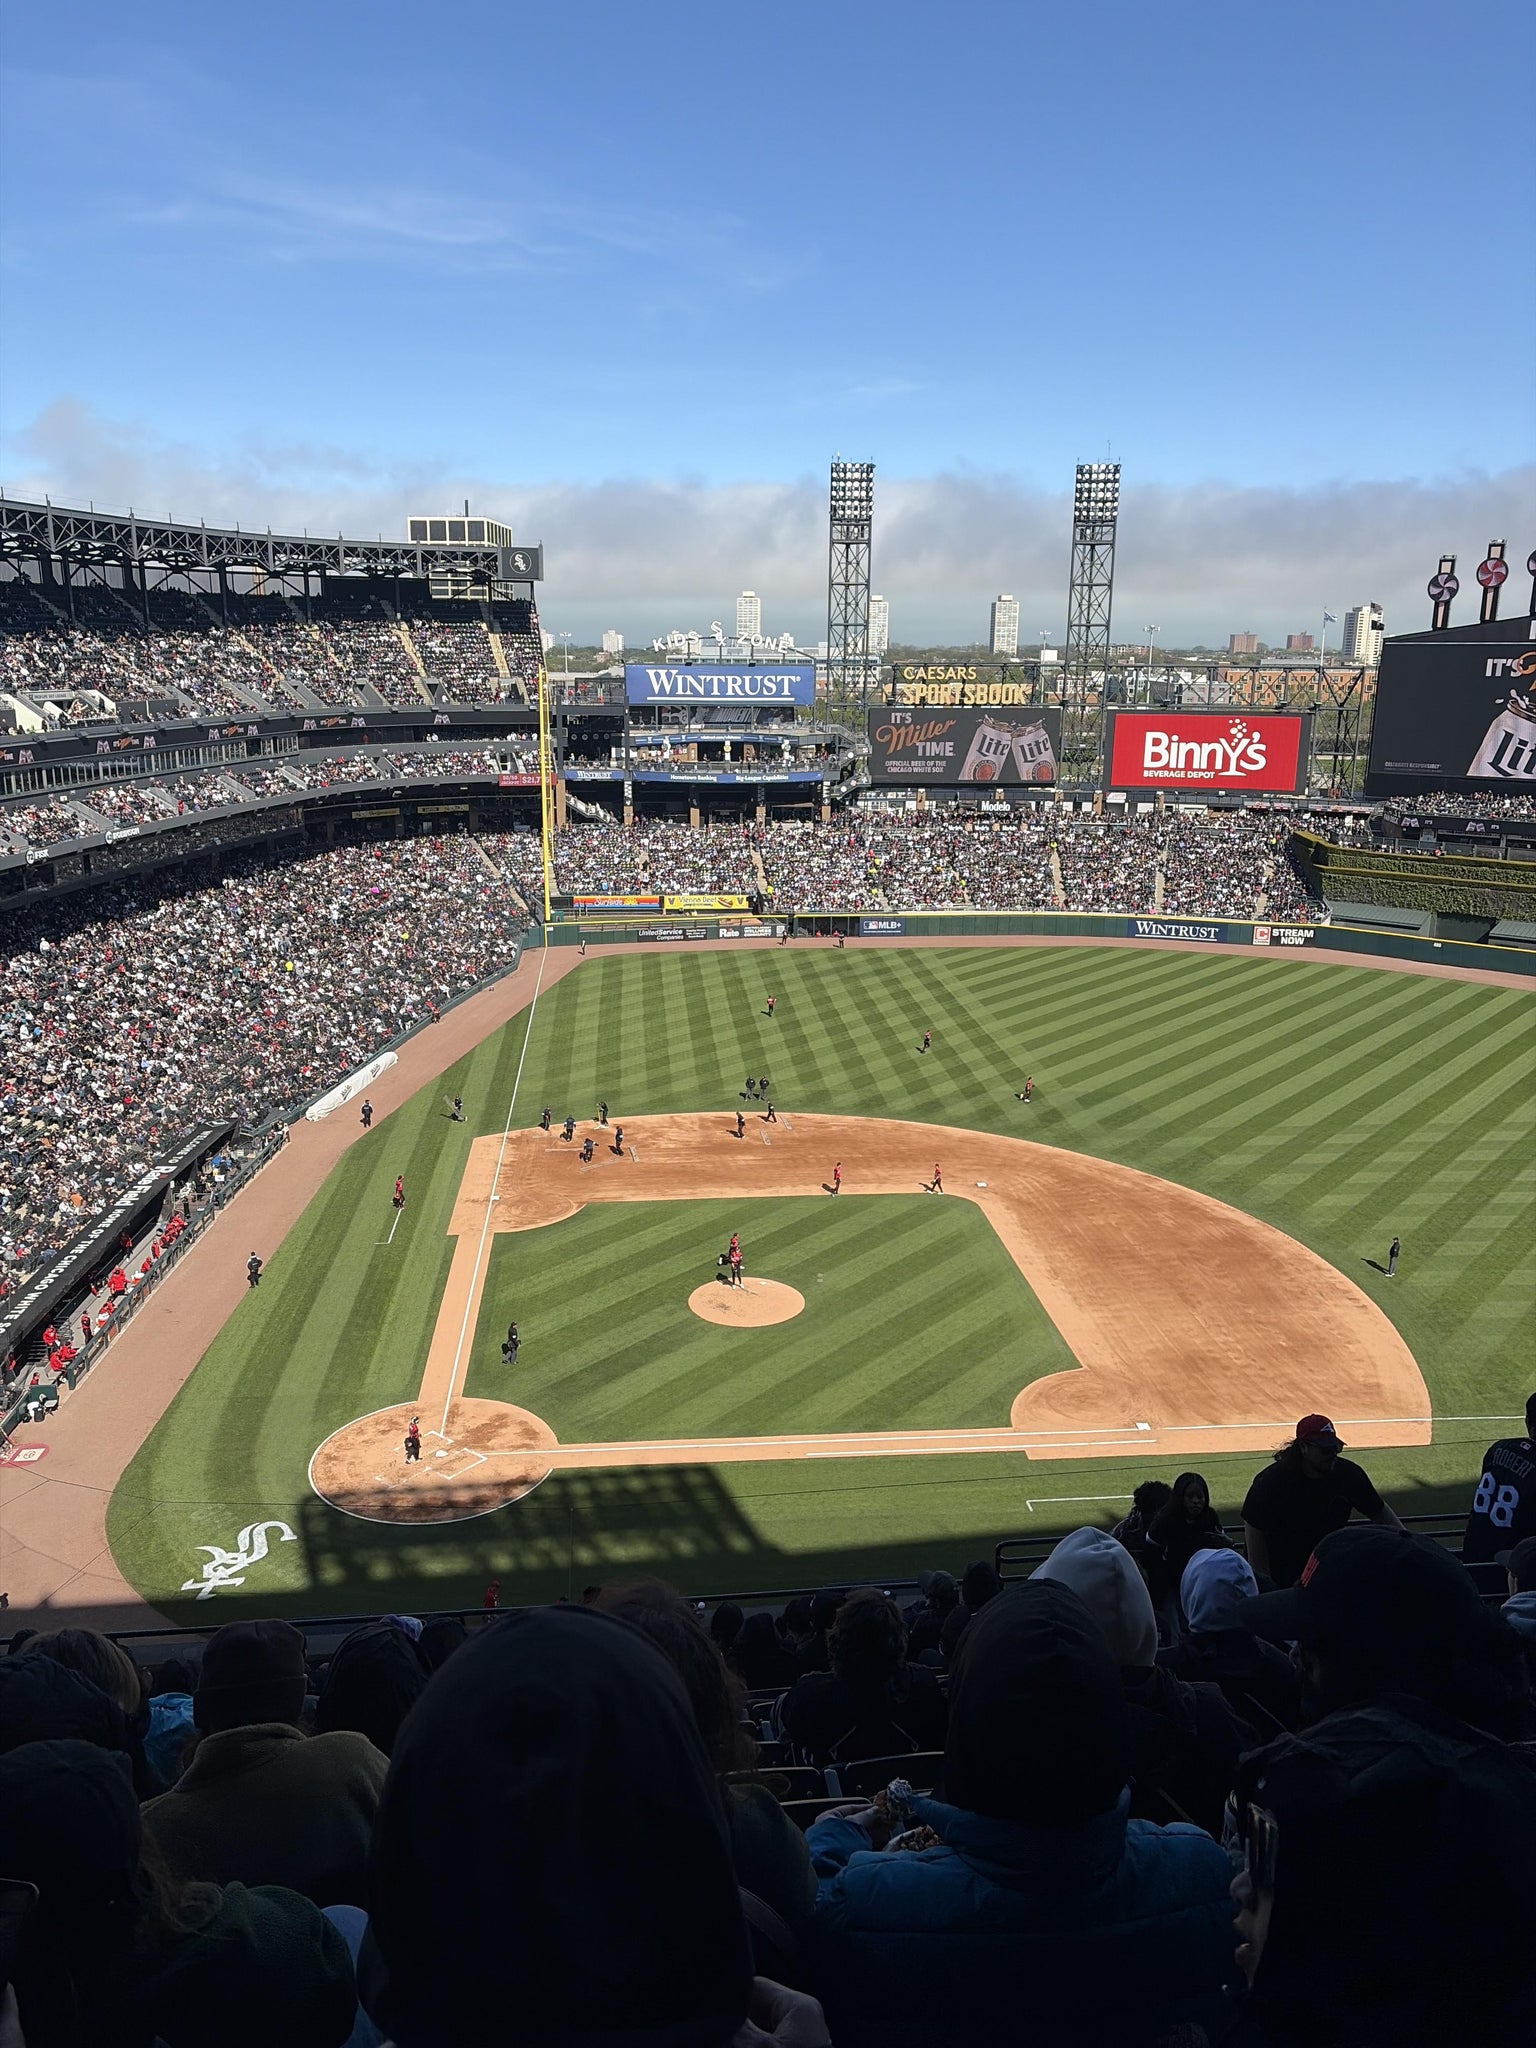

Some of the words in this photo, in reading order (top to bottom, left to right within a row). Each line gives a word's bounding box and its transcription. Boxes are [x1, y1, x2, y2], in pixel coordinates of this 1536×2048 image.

[652, 631, 700, 653] KIDS
[737, 632, 789, 653] ZONE
[903, 666, 977, 680] CAESARS
[1485, 658, 1524, 677] IT'S
[902, 683, 1028, 706] SPORTSBOOK
[890, 712, 912, 724] IT'S
[875, 718, 957, 756] Miller
[976, 733, 1010, 757] Lite
[916, 742, 955, 757] TIME
[1019, 737, 1050, 763] Lite
[1143, 770, 1186, 778] BEVERAGE
[1187, 771, 1215, 779] DEPOT
[981, 800, 1011, 811] Modelo
[879, 921, 902, 929] MLB+
[1135, 920, 1219, 939] WINTRUST
[1272, 928, 1314, 938] STREAM
[1281, 937, 1305, 945] NOW
[177, 1130, 213, 1156] WELCOME
[168, 1156, 184, 1164] TO
[114, 1186, 152, 1206] Field
[97, 1209, 126, 1228] HOME
[88, 1229, 104, 1239] OF
[70, 1239, 94, 1254] THE
[34, 1255, 78, 1291] CHICAGO
[4, 1292, 42, 1320] WHITE
[1492, 1447, 1536, 1479] ROBERT
[1474, 1471, 1520, 1528] 88
